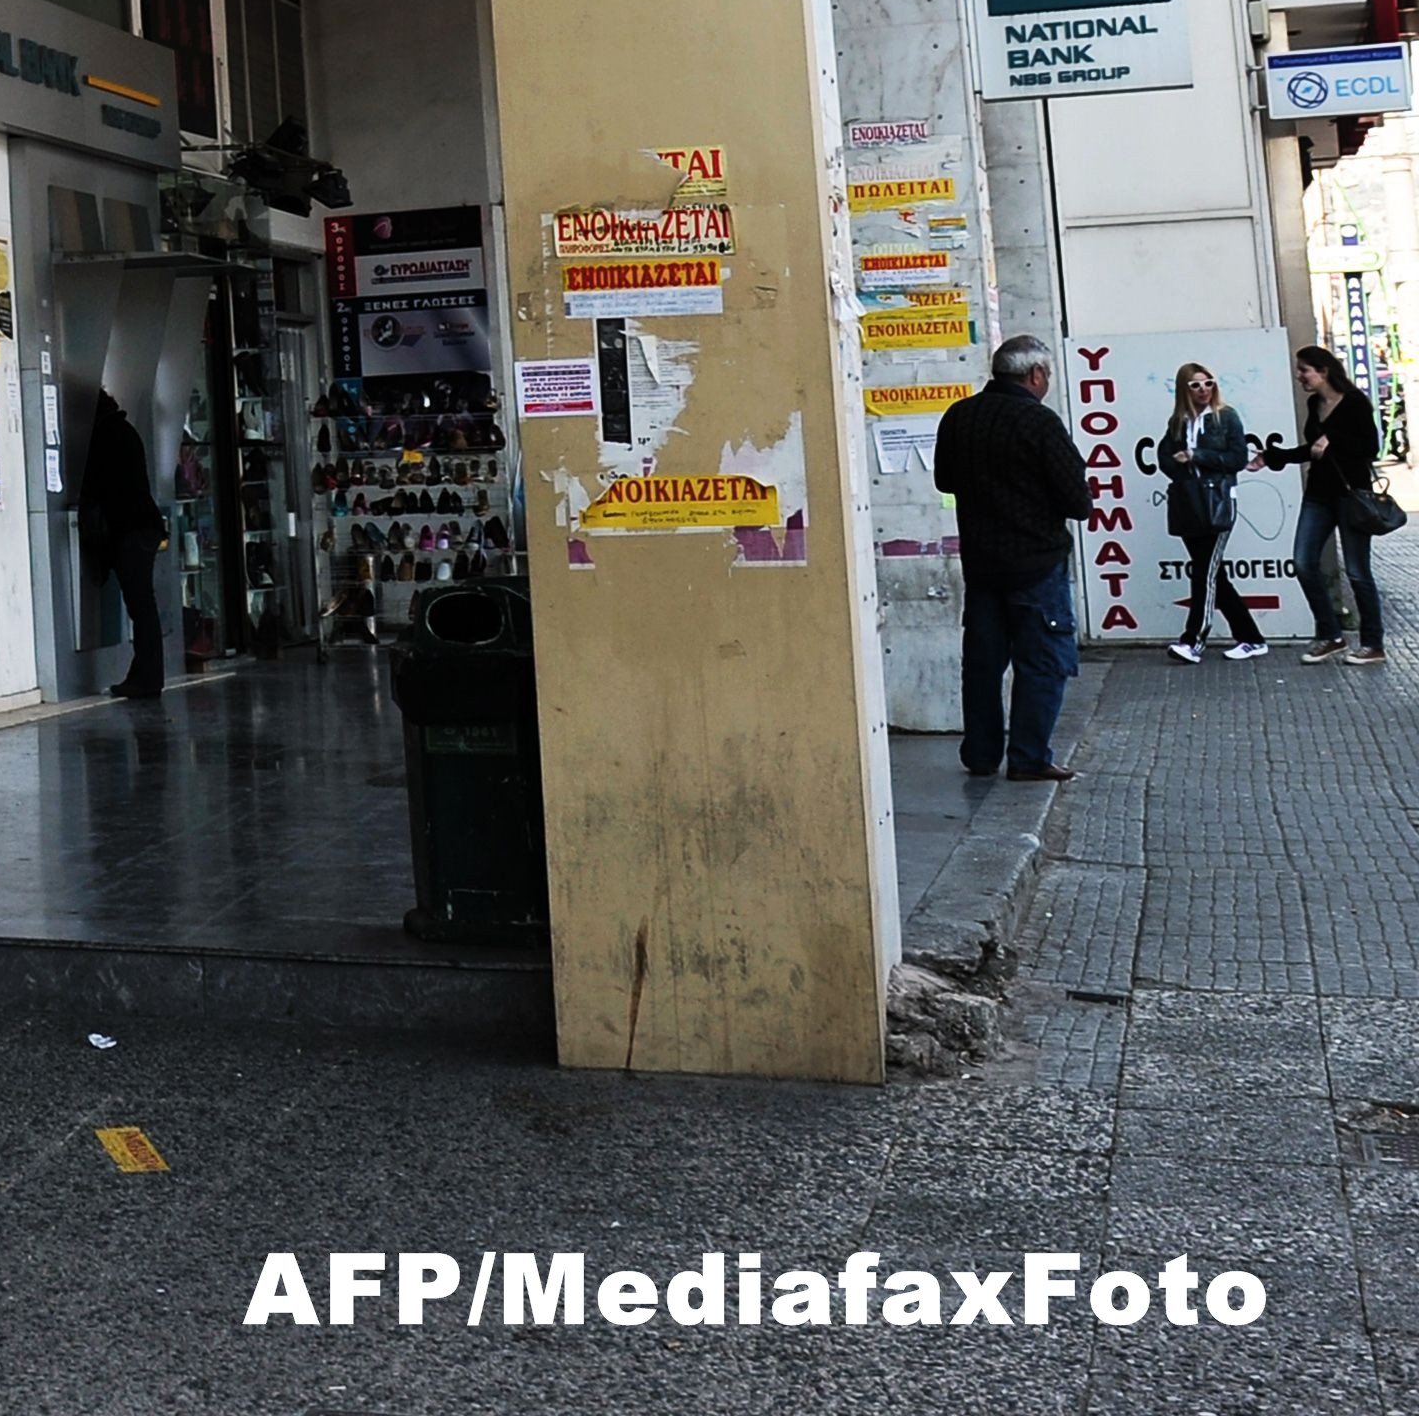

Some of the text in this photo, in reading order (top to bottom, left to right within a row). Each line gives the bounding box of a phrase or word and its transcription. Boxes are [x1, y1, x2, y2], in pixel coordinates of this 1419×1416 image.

[1004, 14, 1158, 45] NATIONAL
[1007, 44, 1095, 70] BANK
[1009, 65, 1131, 87] NBG GROUP
[1335, 75, 1400, 98] ECDL
[657, 149, 722, 180] ΤΑΙ
[854, 181, 950, 198] ΠΩΛΕΙΤΑΙ
[390, 259, 469, 277] ΕΥΡΩΔΙΑΣΤΑΣΗ
[566, 261, 719, 291] ΕΝΟΙΚΙΑΖΕΤΑΙ
[364, 299, 409, 312] ΞΕΝΕΣ
[413, 295, 476, 308] ΓΛΩΣΣΕΣ
[867, 320, 964, 338] ΕΝΟΙΚΙΑΖΕΤΑΙ
[870, 385, 968, 403] ΕΝΟΙΚΙΑΖΕΤΑΙ
[1077, 346, 1138, 630] ΥΠΟΔΗΜΑΤΑ
[1224, 559, 1298, 579] ΠΟΓΕΙΟ
